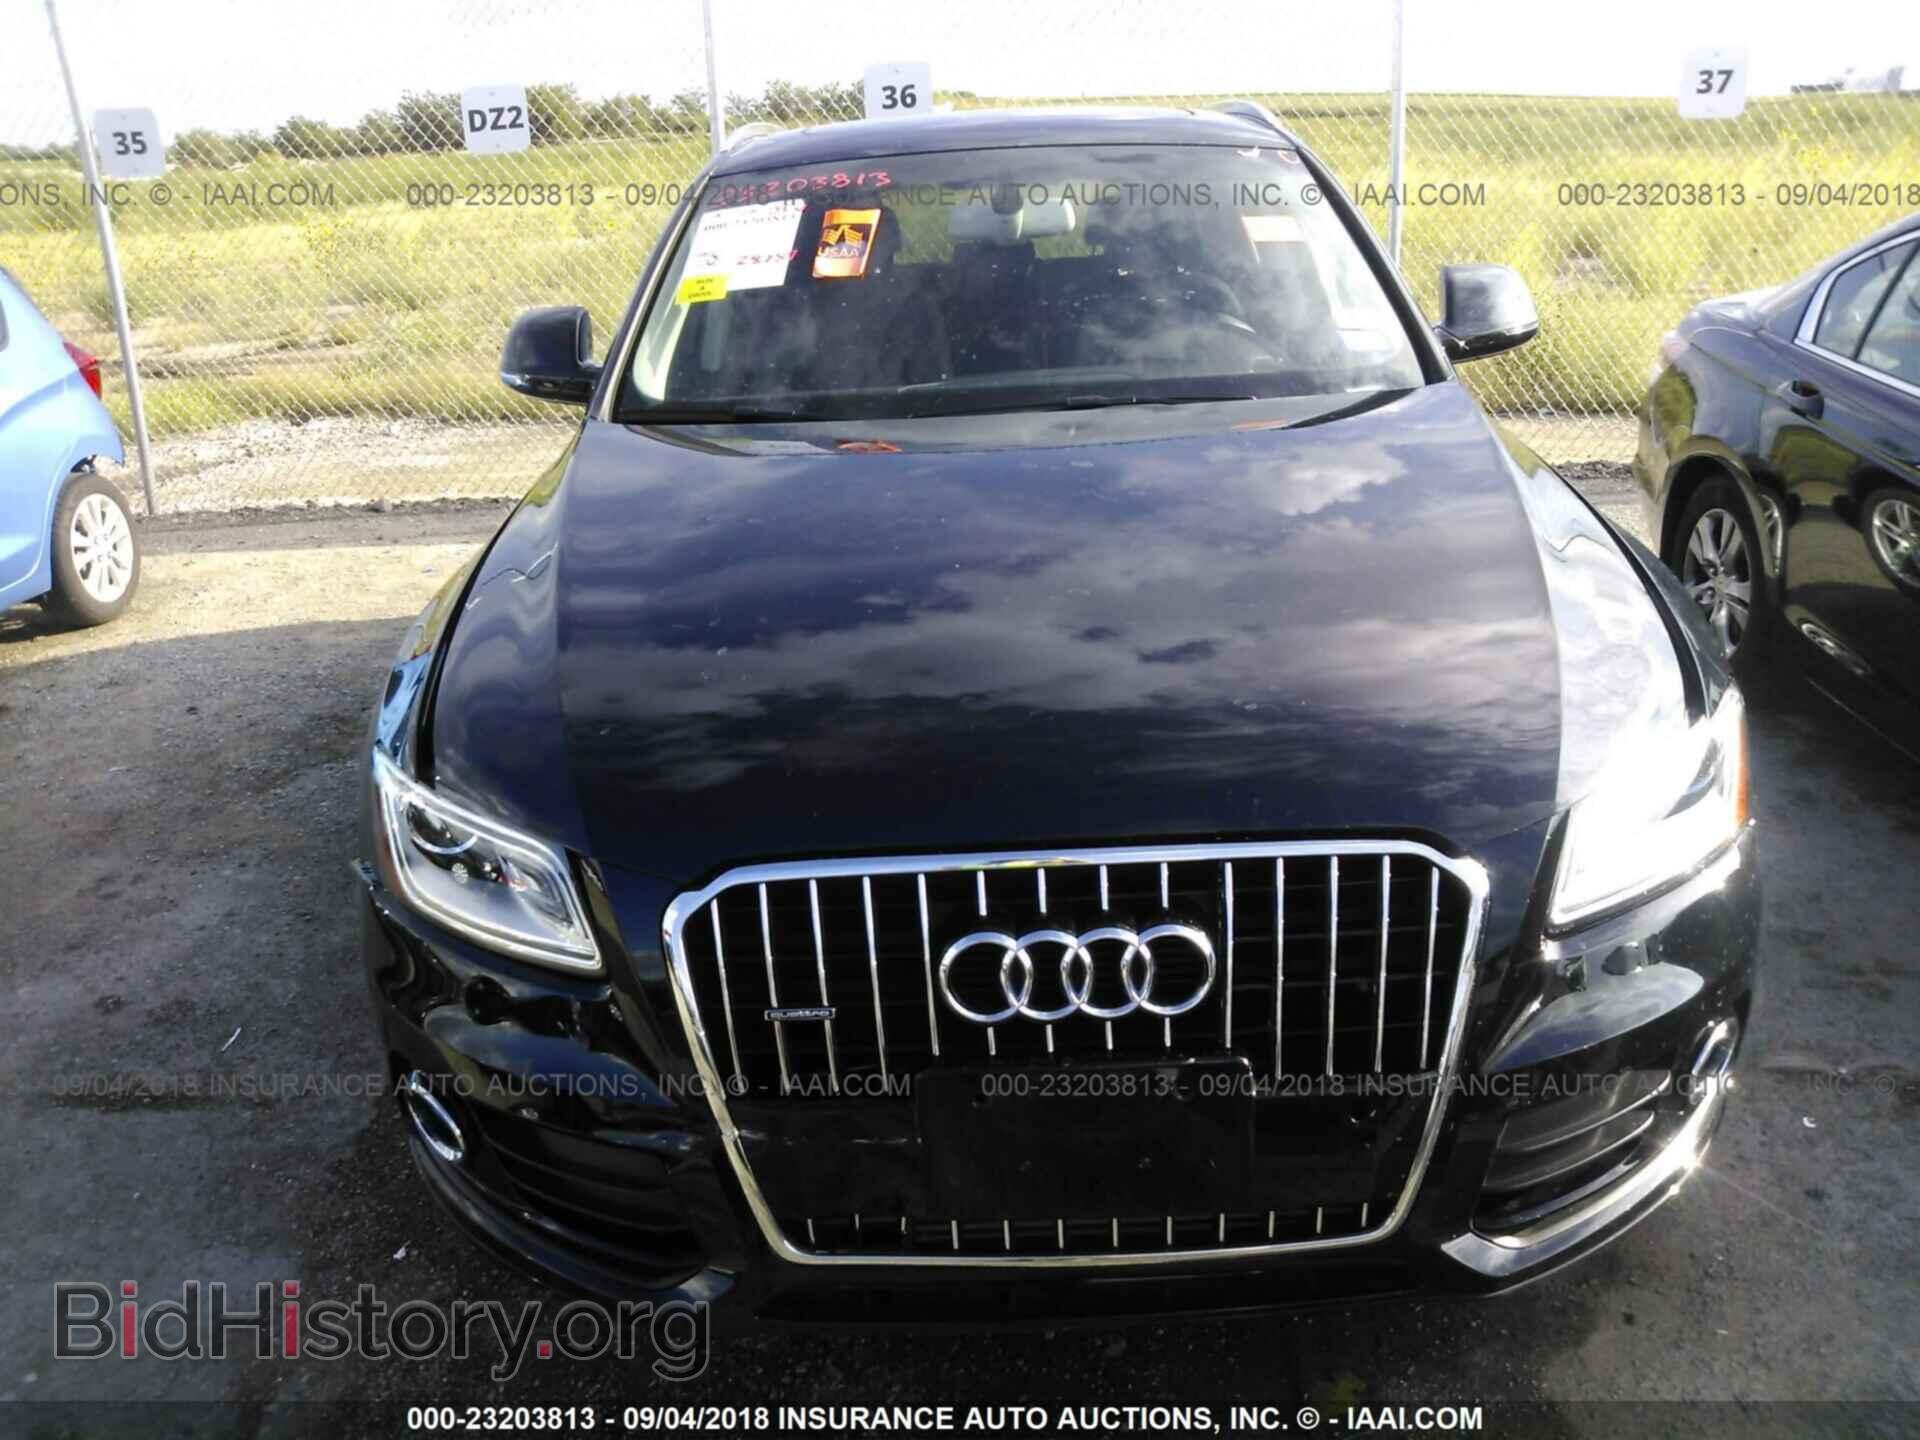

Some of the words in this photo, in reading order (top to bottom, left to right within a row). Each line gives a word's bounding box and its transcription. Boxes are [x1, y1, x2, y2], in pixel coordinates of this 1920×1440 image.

[1696, 69, 1734, 95] 37
[881, 84, 917, 110] 36
[468, 105, 524, 132] DZ2
[112, 131, 148, 155] 35
[818, 247, 859, 257] USAA
